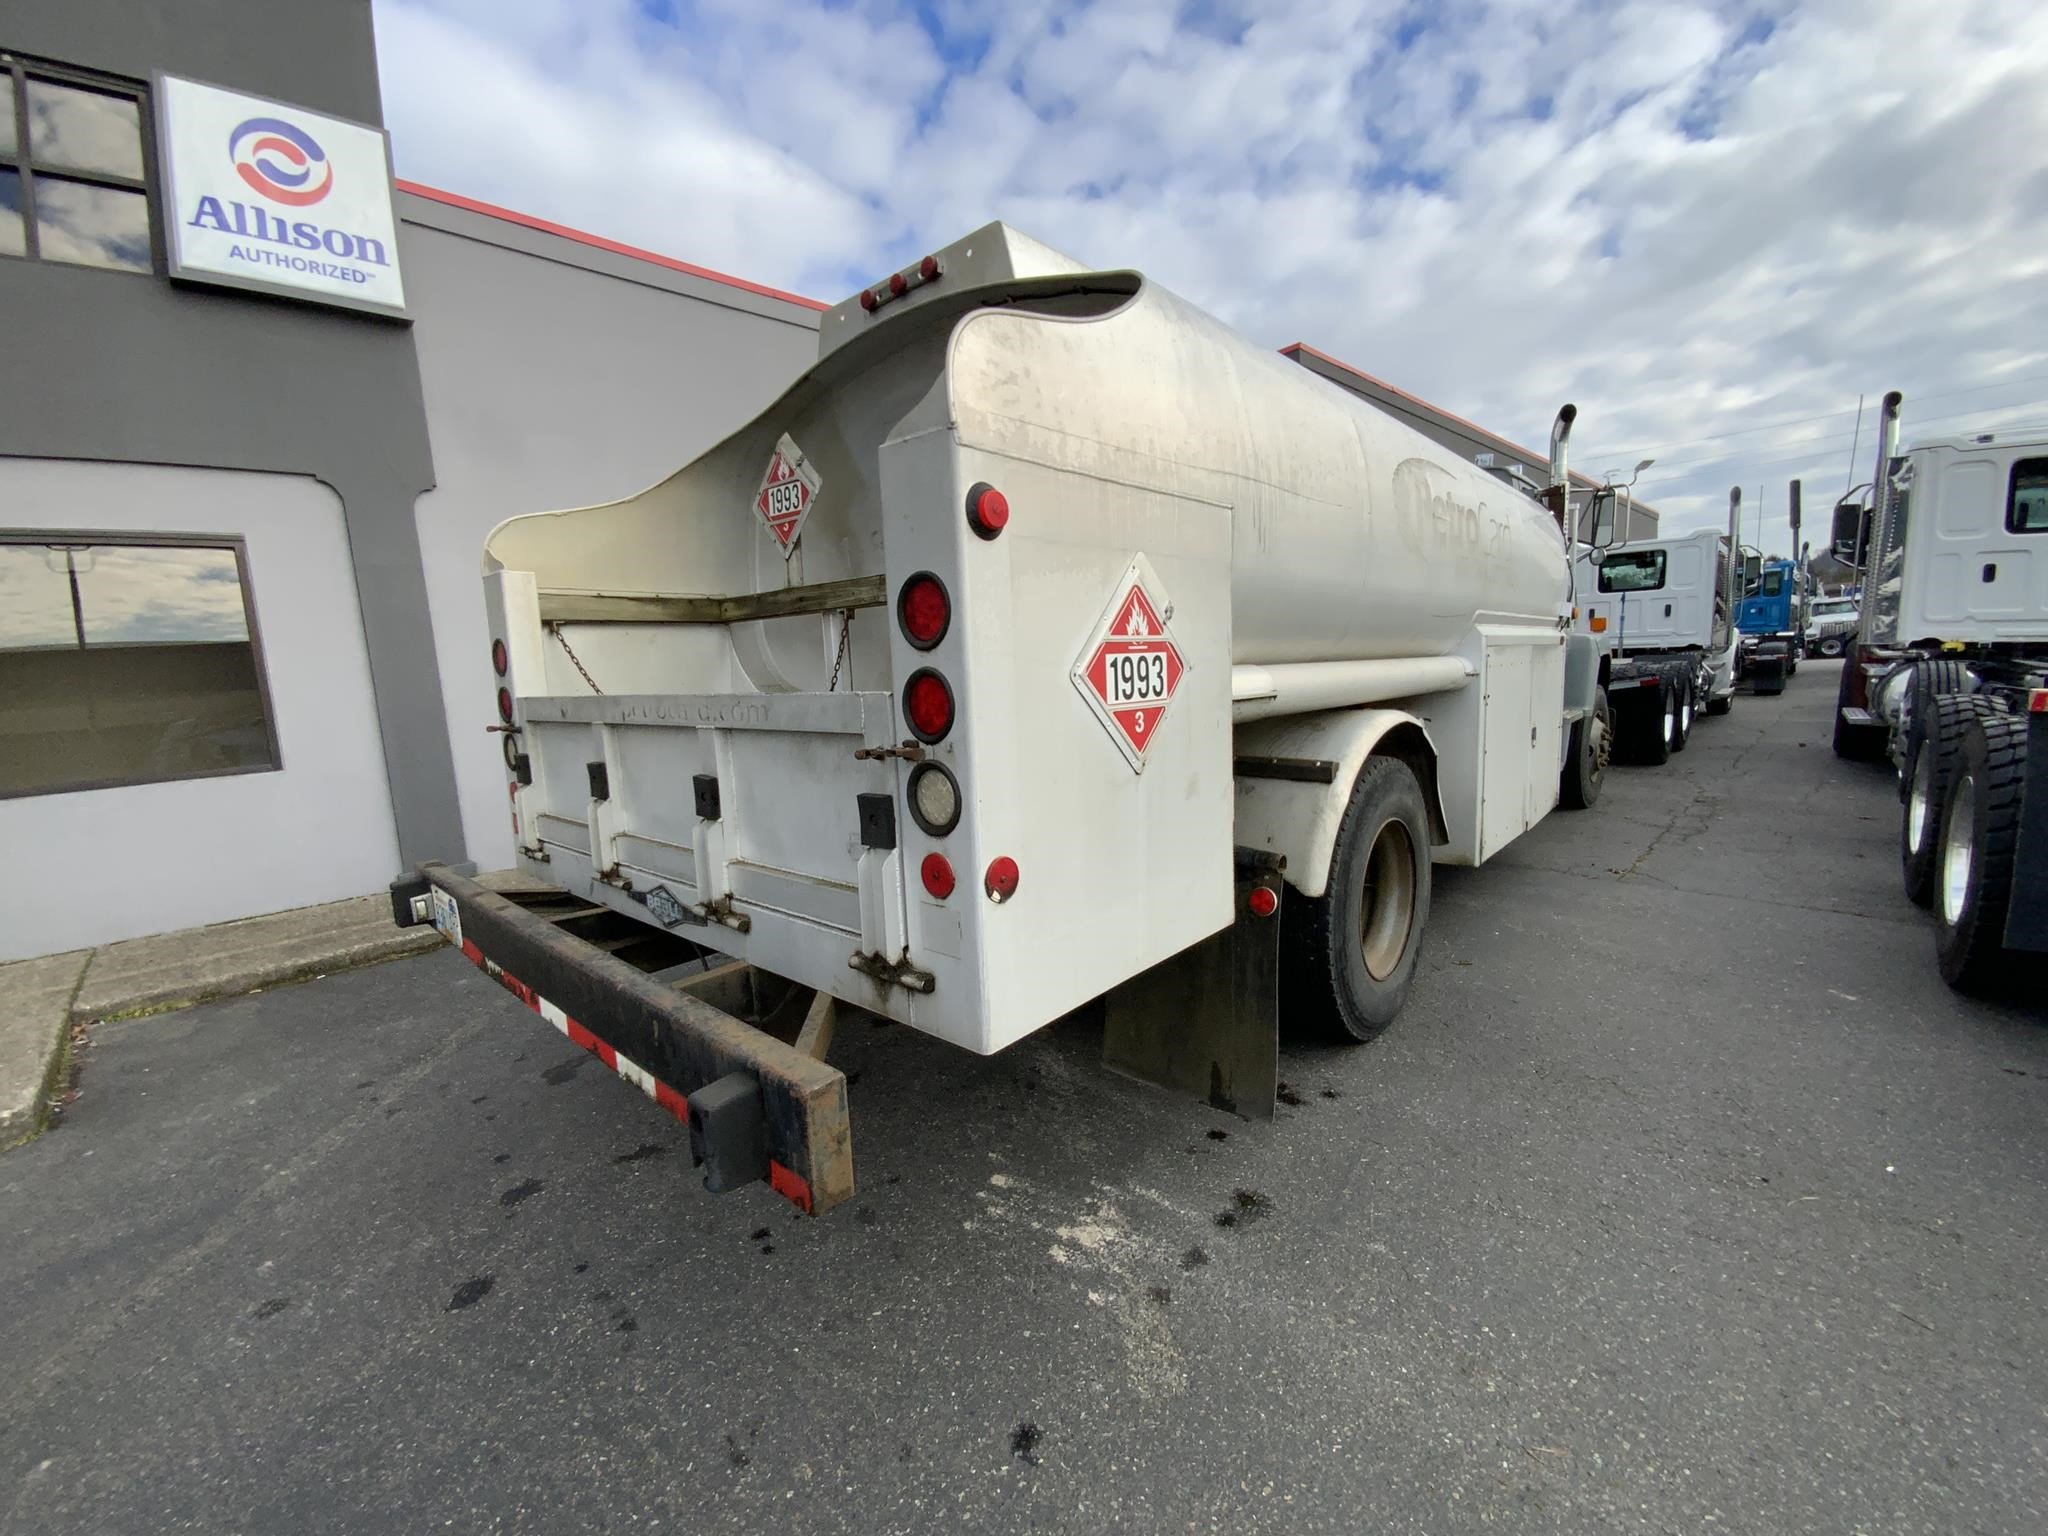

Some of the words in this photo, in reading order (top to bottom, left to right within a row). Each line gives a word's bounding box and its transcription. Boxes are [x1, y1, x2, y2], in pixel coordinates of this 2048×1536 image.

[187, 195, 391, 267] Allison
[229, 245, 366, 284] AUTHORIZED
[771, 484, 800, 514] 1993
[783, 523, 789, 532] 3
[1110, 655, 1164, 701] 1993
[1135, 711, 1145, 733] 3
